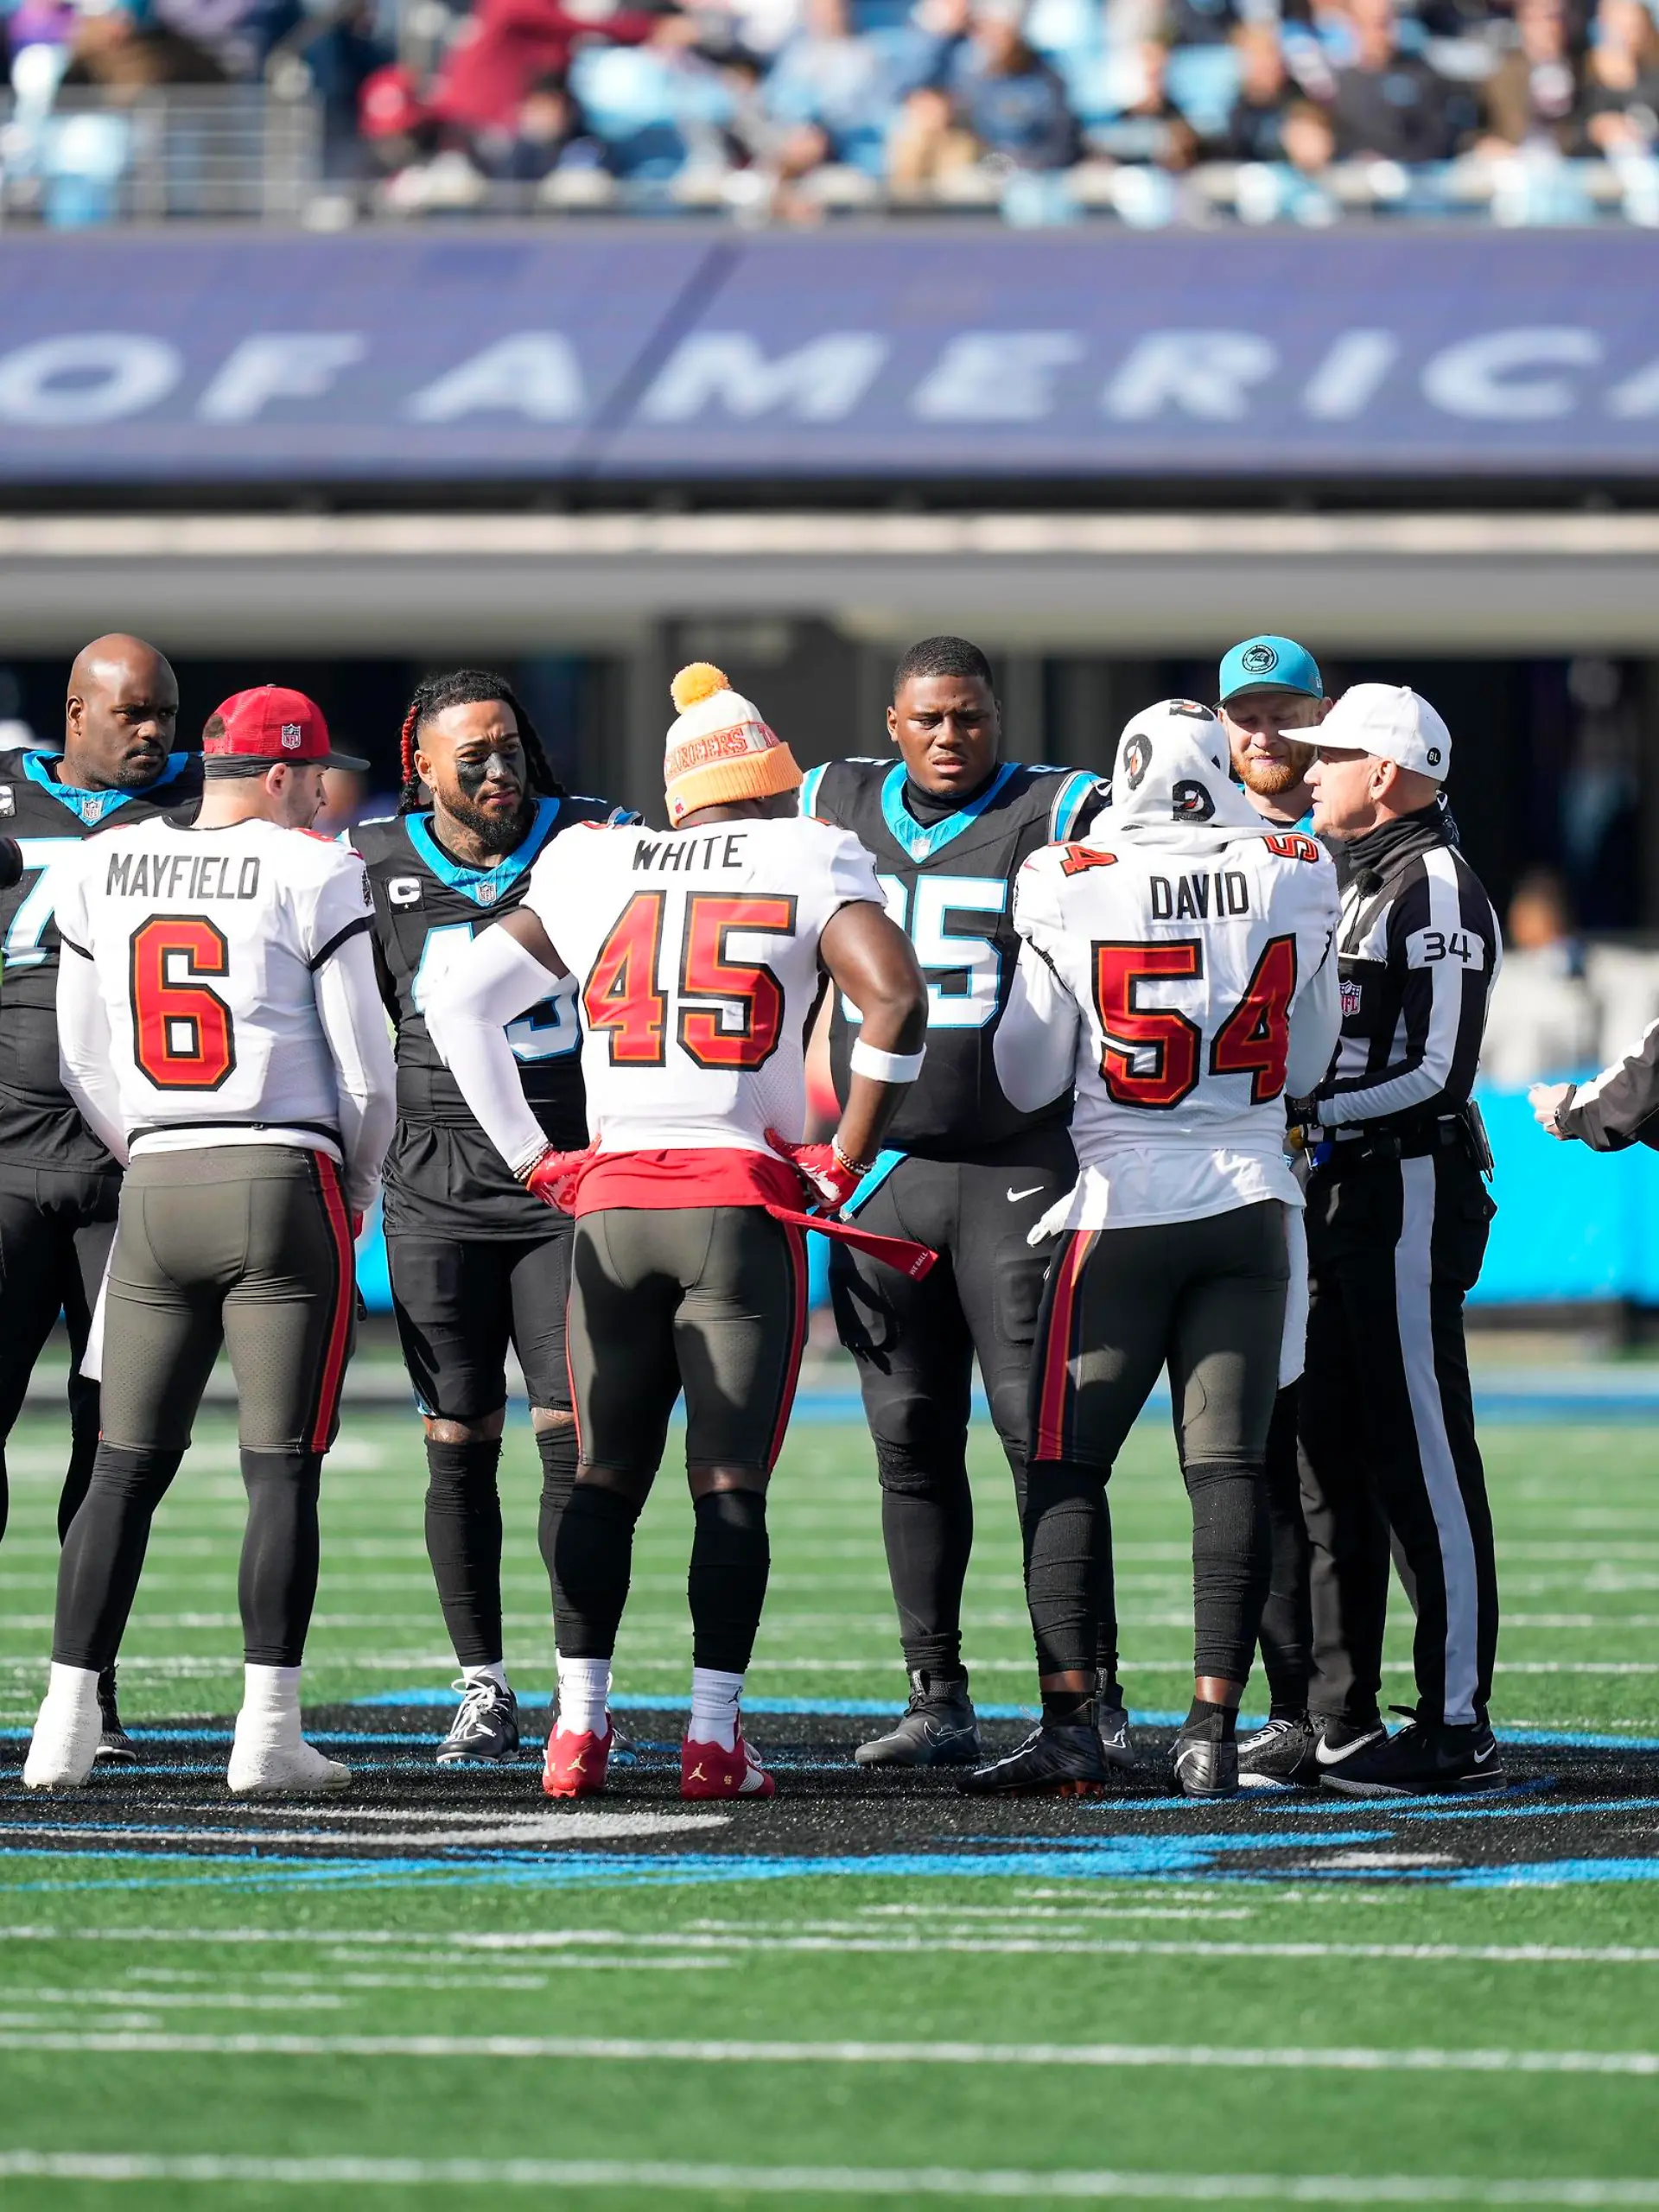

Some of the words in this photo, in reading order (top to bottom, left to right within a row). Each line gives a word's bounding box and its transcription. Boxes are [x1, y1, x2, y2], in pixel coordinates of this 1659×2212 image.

[0, 331, 367, 424] OF
[403, 327, 1659, 423] AMERIC
[1428, 751, 1439, 762] BL
[632, 834, 747, 870] WHITE
[1048, 840, 1119, 877] 4
[106, 853, 261, 899] MAYFIELD
[388, 878, 421, 904] C
[1150, 871, 1249, 919] DAVID
[1423, 932, 1471, 963] 34
[129, 914, 236, 1090] 6
[583, 889, 798, 1071] 45
[1090, 932, 1298, 1110] 54
